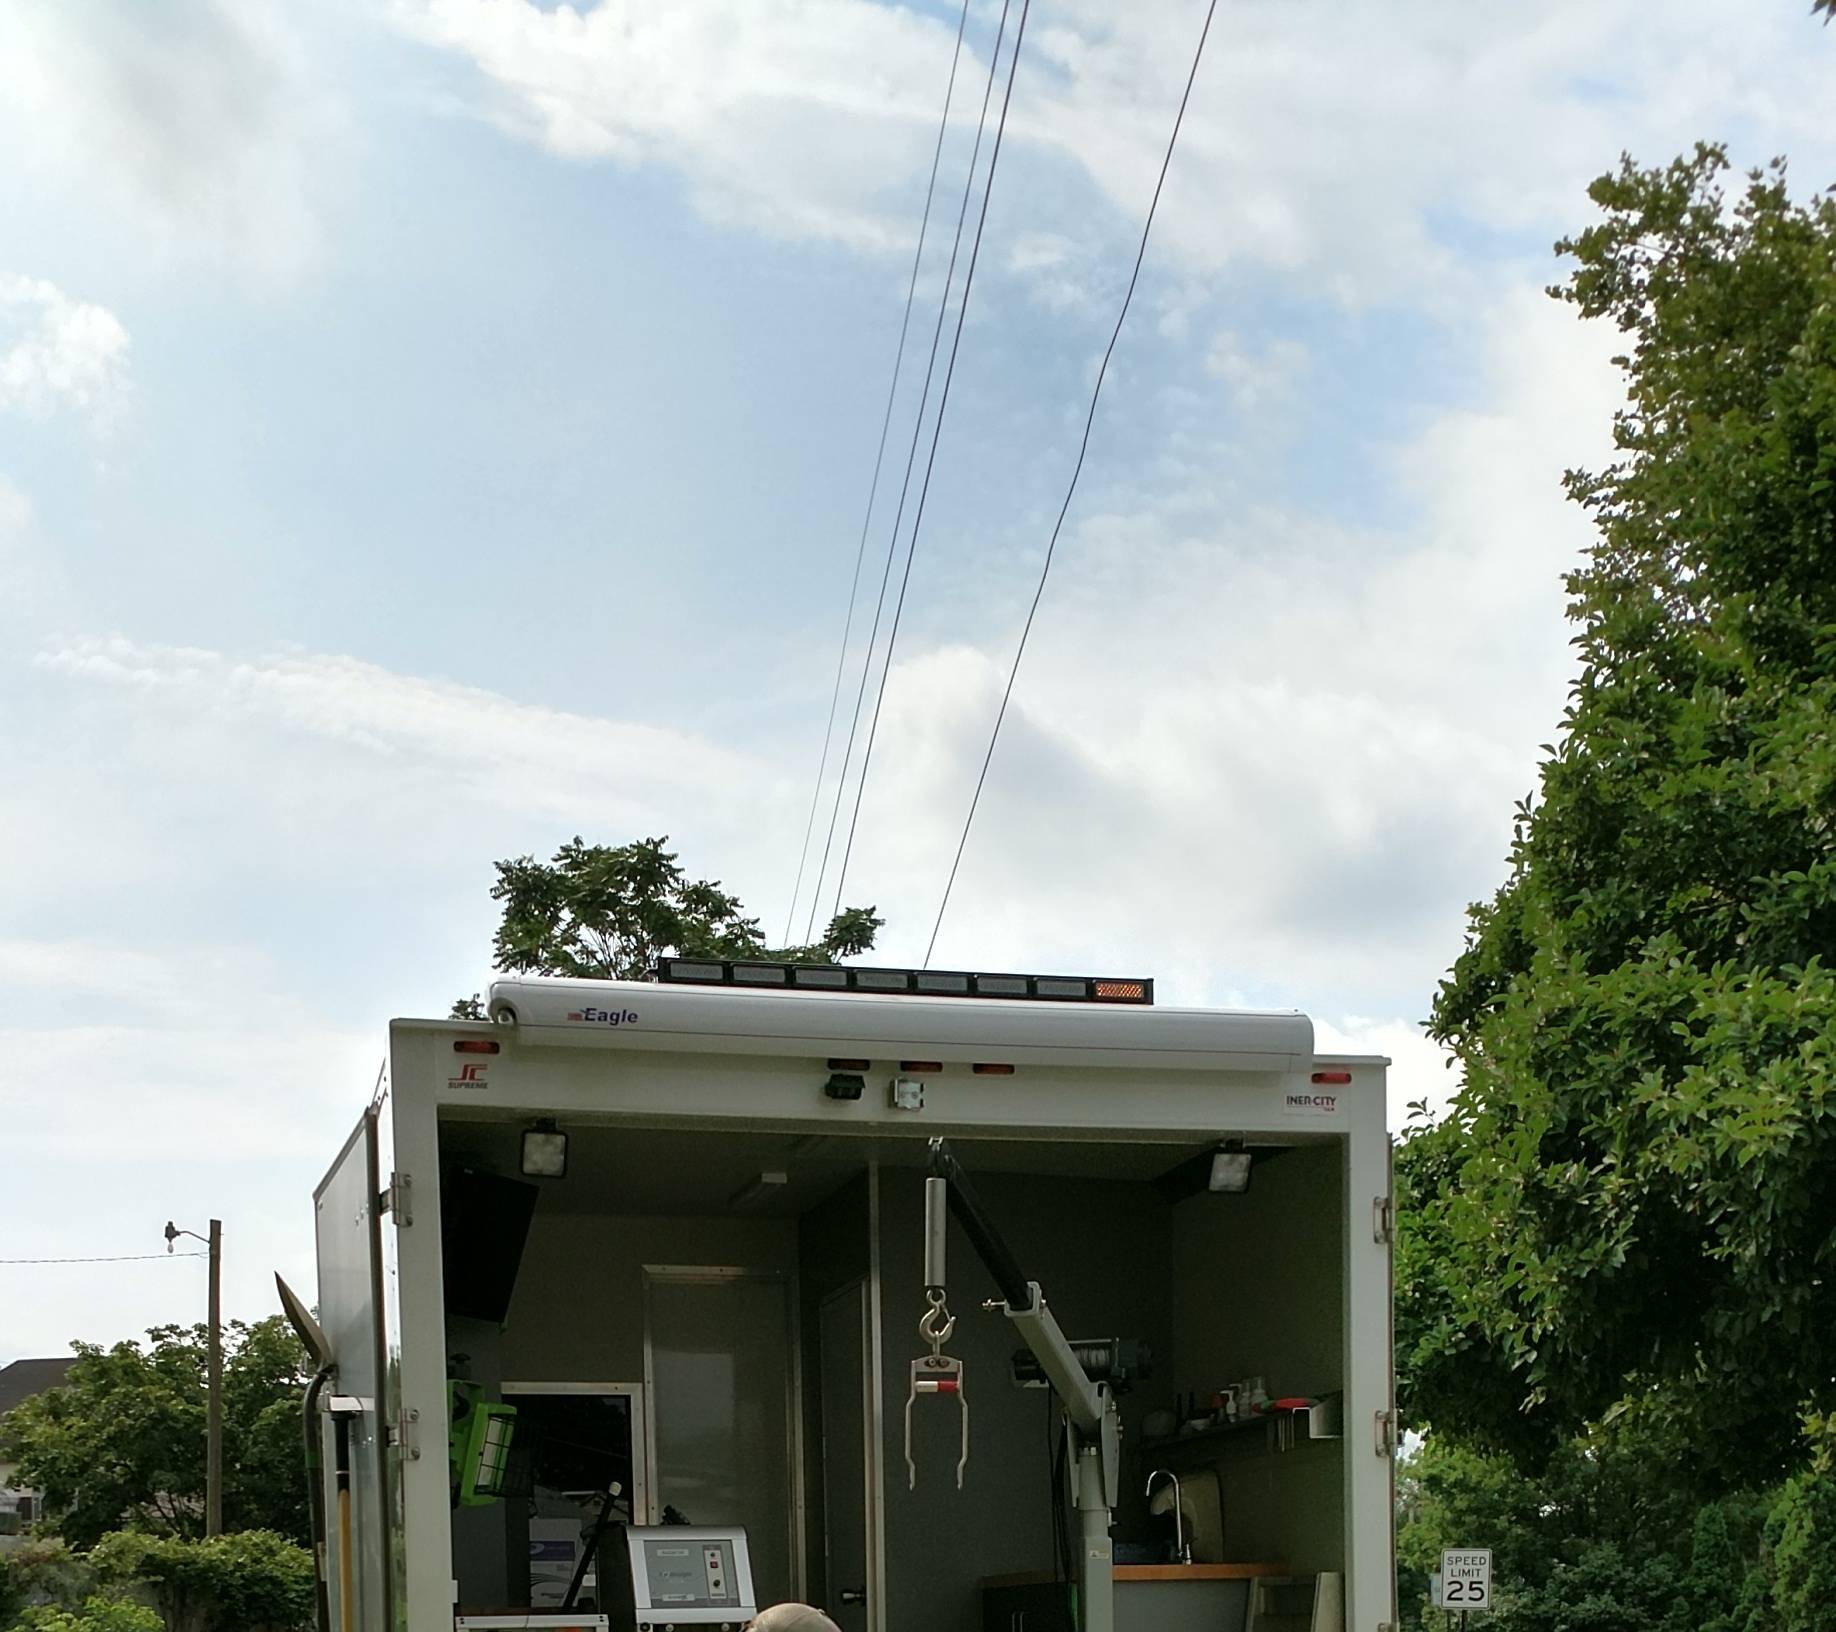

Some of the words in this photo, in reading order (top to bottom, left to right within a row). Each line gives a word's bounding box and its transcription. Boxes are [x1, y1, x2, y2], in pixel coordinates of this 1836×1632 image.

[584, 1007, 639, 1026] Eagle
[447, 1081, 488, 1090] SUPREME
[1447, 1556, 1487, 1566] SPEED
[1450, 1568, 1482, 1578] LIMIT
[1446, 1580, 1485, 1602] 25
